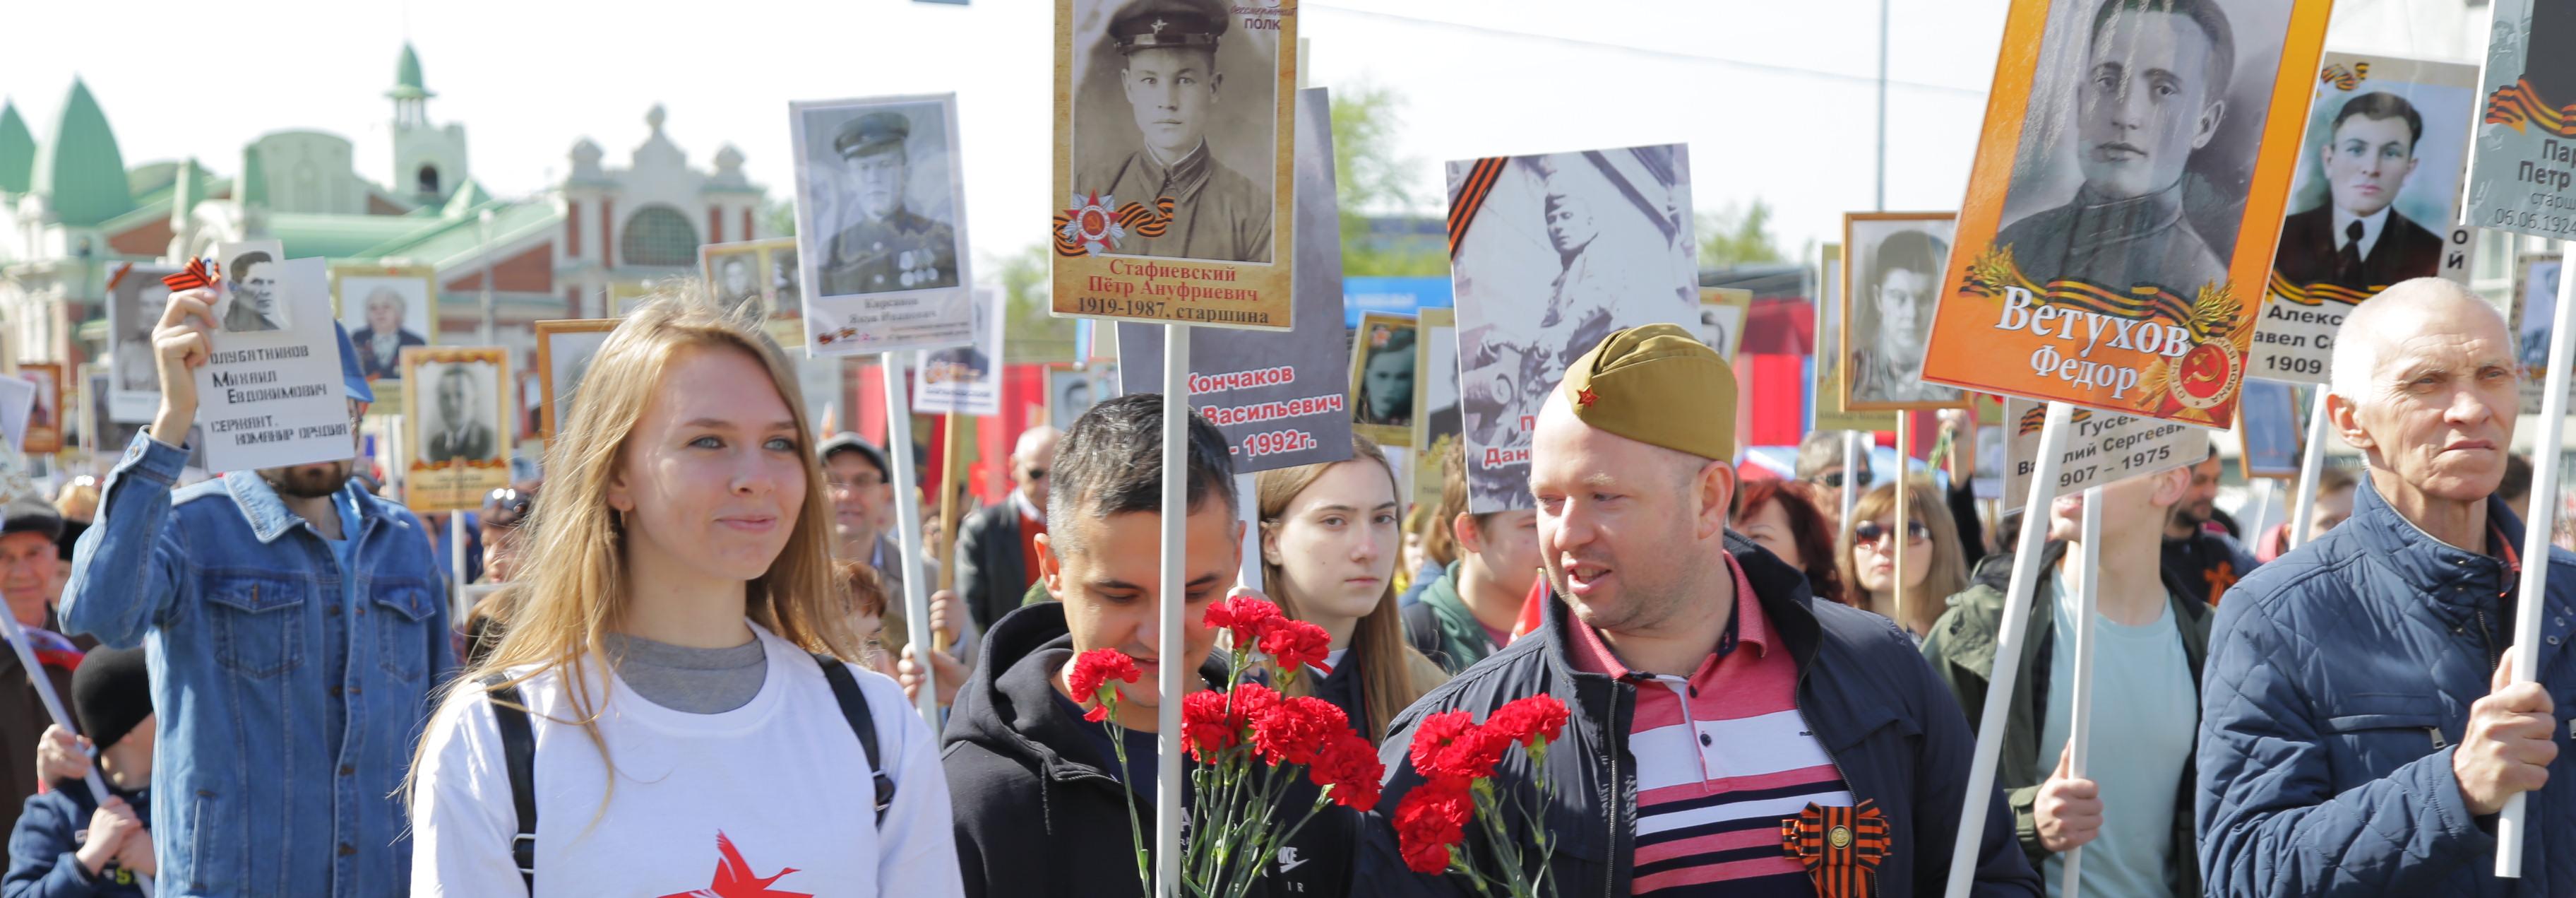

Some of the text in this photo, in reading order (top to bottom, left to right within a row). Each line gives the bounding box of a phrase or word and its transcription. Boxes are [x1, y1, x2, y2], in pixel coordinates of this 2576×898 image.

[1245, 18, 1280, 30] ПОЛК
[2518, 160, 2570, 191] Петр
[1109, 259, 1236, 281] Стафиевский
[1088, 276, 1258, 301] Пётр Ануфриевич
[1078, 297, 1268, 324] 1919-1987, старшина
[1995, 285, 2190, 358] Ветухов
[2267, 305, 2343, 326] Алекс
[2254, 331, 2306, 347] авел
[210, 345, 309, 365] ОЛУБЯТНИКОВ
[2266, 355, 2322, 374] 1909
[2030, 344, 2137, 400] Федор
[1201, 394, 1343, 427] Васильевич
[2080, 416, 2139, 437] Гусе
[1244, 429, 1318, 456] 1992г.
[2060, 466, 2098, 487] 907
[2122, 445, 2170, 470] 1975
[1277, 846, 1298, 863] IKE
[1288, 882, 1304, 892] IR
